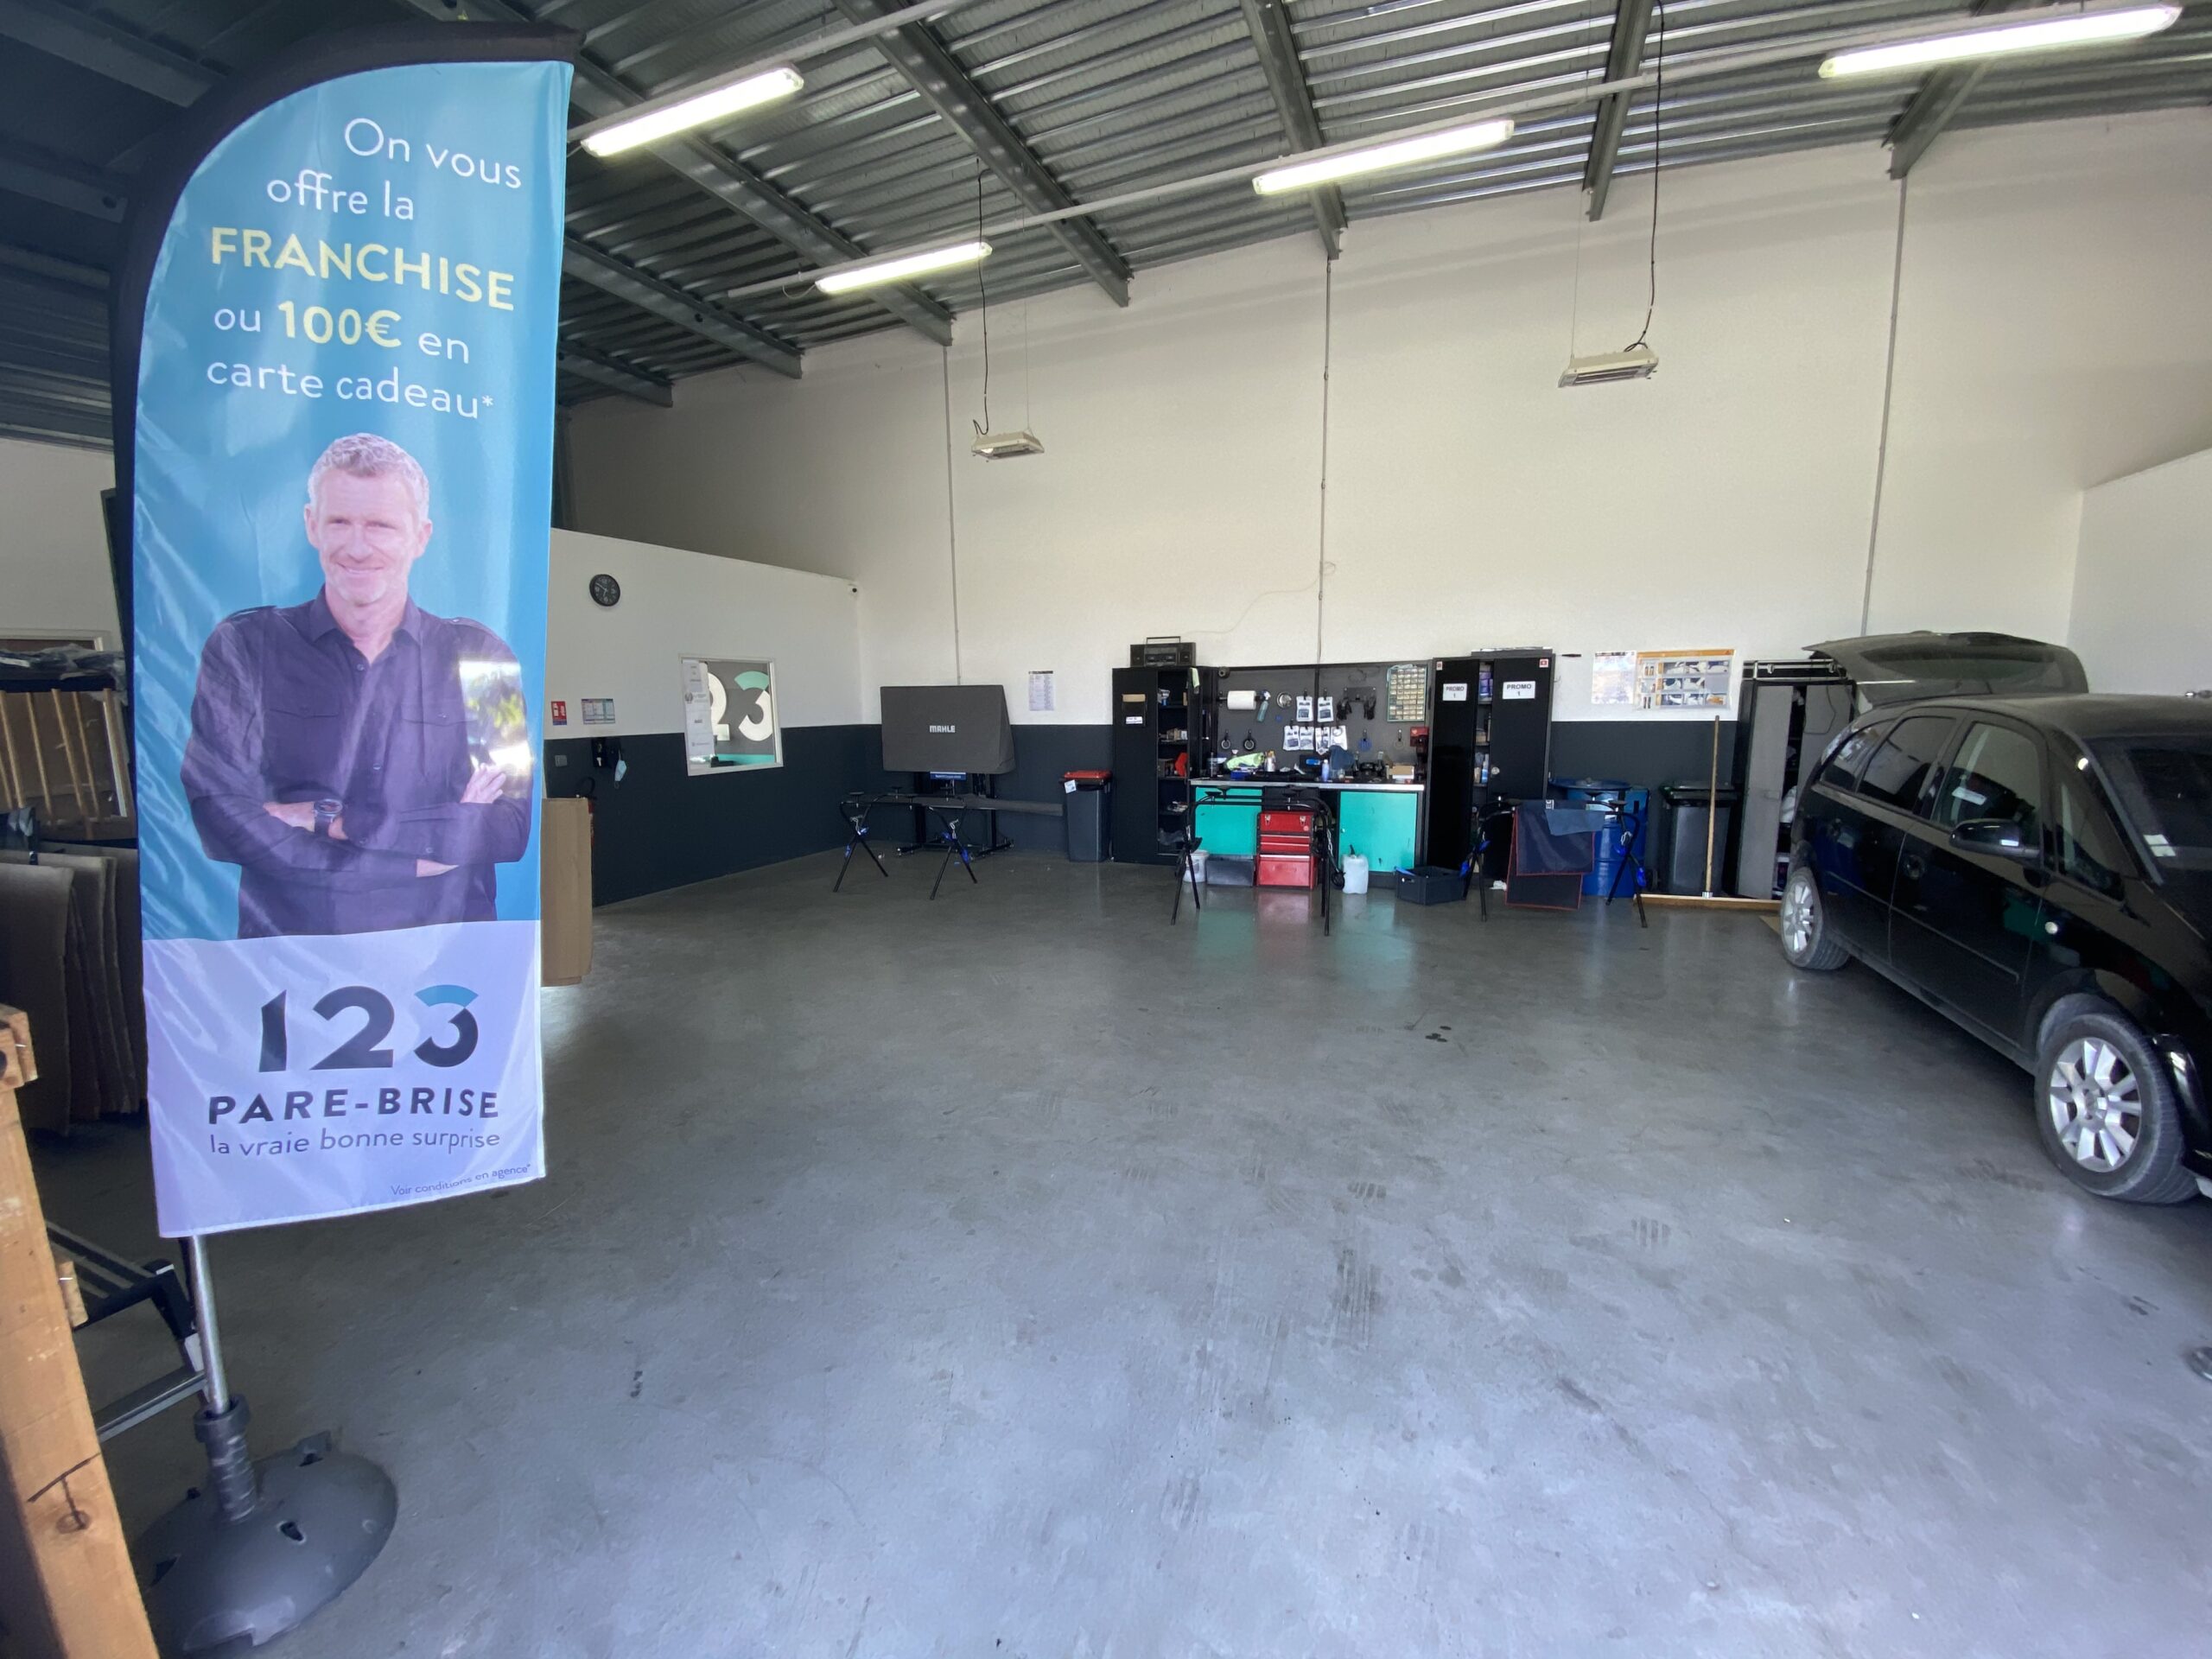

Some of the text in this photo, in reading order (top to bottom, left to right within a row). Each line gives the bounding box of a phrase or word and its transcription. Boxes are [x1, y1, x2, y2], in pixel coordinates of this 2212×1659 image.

[345, 118, 522, 189] On vous
[267, 168, 414, 220] offre la
[211, 226, 515, 311] FRANCHISE
[213, 301, 469, 364] ou 100€ en
[207, 361, 324, 398] carte
[259, 984, 479, 1072] 123
[208, 1087, 499, 1125] PARE-BRISE
[210, 1128, 500, 1156] la vraie bonne surprise
[391, 1185, 412, 1195] Voir
[415, 1177, 473, 1193] conditions
